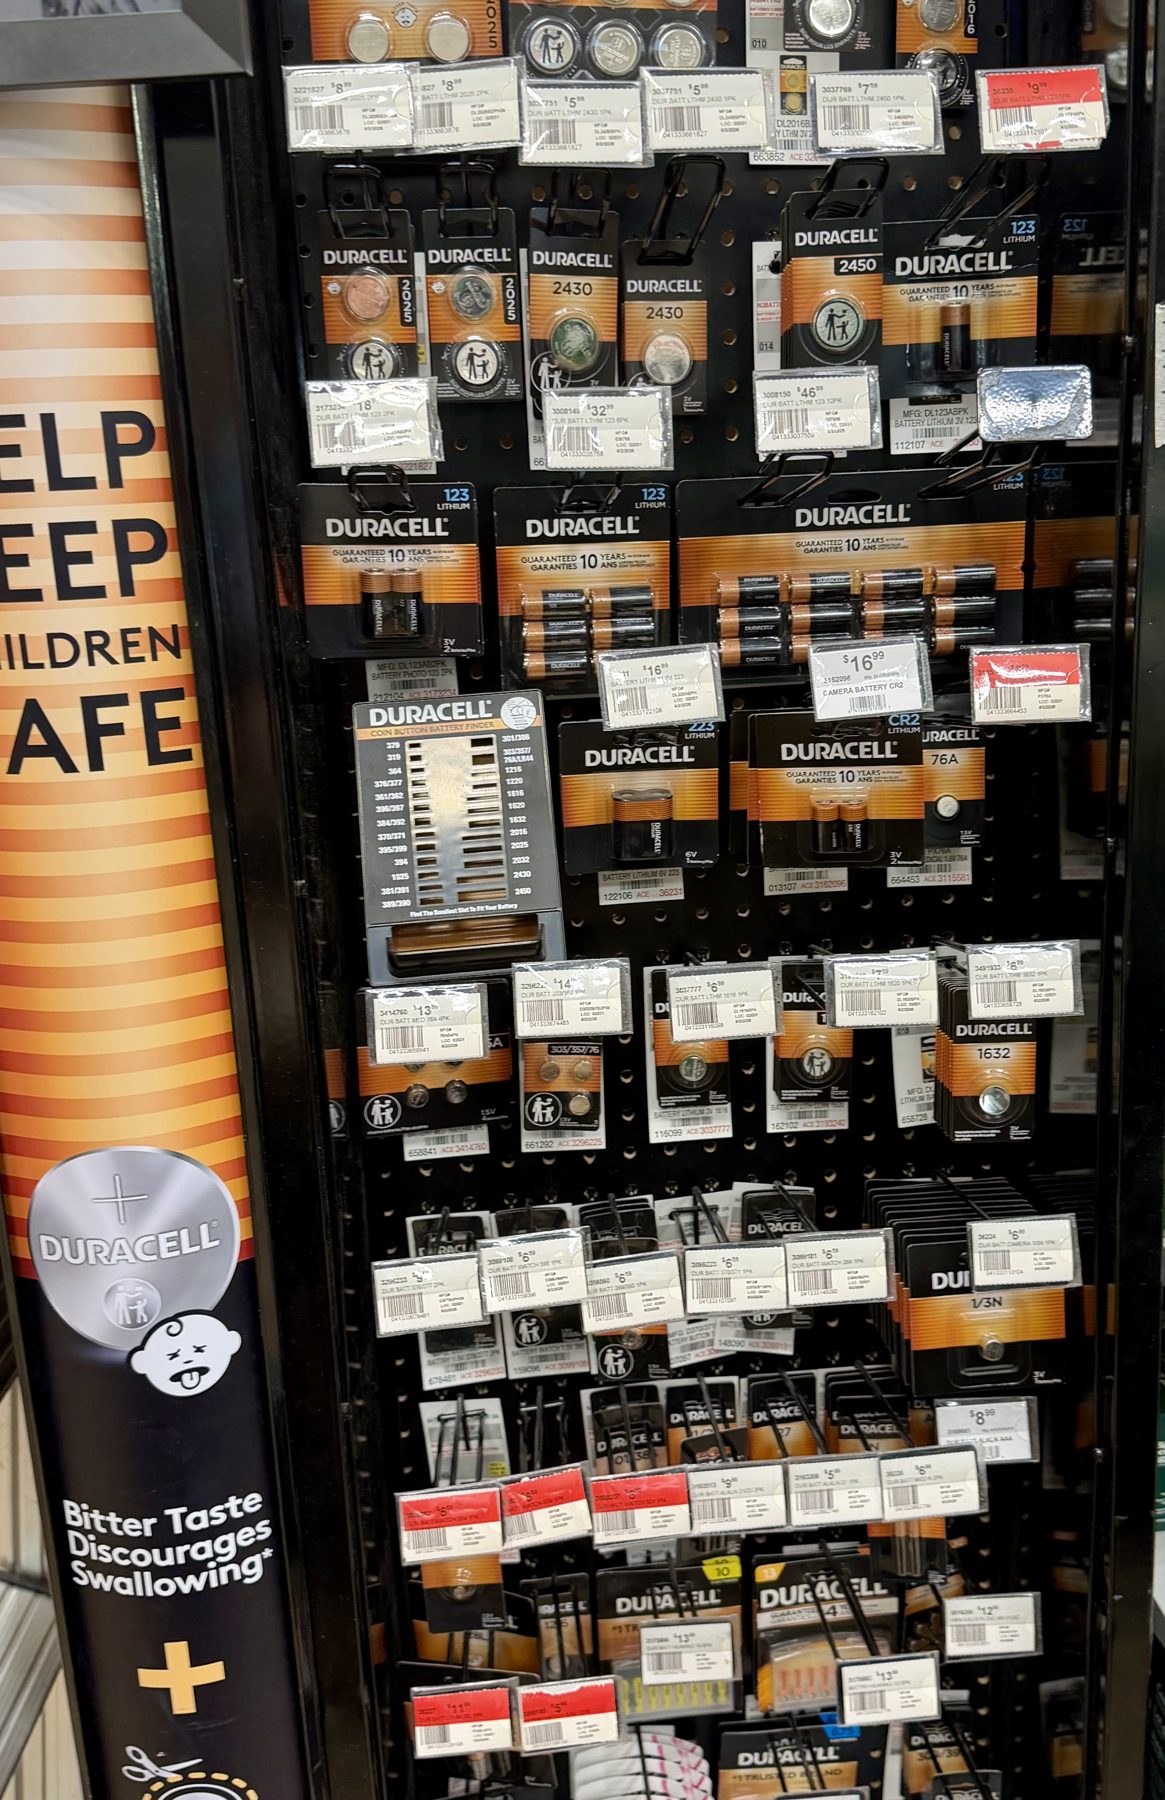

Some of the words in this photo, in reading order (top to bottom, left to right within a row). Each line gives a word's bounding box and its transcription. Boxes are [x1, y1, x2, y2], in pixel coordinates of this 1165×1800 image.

[752, 40, 767, 48] 010
[754, 152, 785, 161] 663852
[1010, 220, 1036, 234] 123
[794, 228, 878, 247] DURACELL
[1003, 235, 1036, 243] LITHIUM
[323, 250, 407, 264] DURACELL
[428, 248, 512, 263] DURACELL
[532, 251, 613, 267] DURACELL
[839, 258, 877, 273] 2450
[895, 251, 1014, 276] DURACELL
[552, 282, 593, 296] 2430
[626, 279, 702, 293] DURACELL
[899, 286, 950, 296] GUARANTEED
[952, 285, 969, 298] 10
[971, 283, 995, 291] YEARS
[401, 279, 412, 323] 2025
[505, 278, 516, 320] 2025
[645, 307, 683, 320] 2430
[759, 342, 773, 351] 014
[894, 418, 926, 428] BATTERY
[927, 416, 954, 427] LITHIUM
[0, 410, 156, 493] ELP
[895, 441, 926, 450] 112107
[443, 488, 469, 501] 123
[641, 487, 666, 500] 123
[795, 504, 911, 527] DURACELL
[325, 518, 449, 537] DURACELL
[525, 516, 640, 538] DURACELL
[804, 546, 843, 554] GARANTIES
[845, 538, 860, 551] 10
[0, 518, 168, 603] EEP
[388, 549, 405, 563] 10
[520, 555, 577, 564] GUARANTEED
[580, 554, 598, 569] 10
[530, 563, 578, 571] GARANTIES
[0, 623, 182, 670] ILDREN
[823, 687, 854, 696] CAMERA
[855, 683, 888, 693] BATTERY
[369, 700, 492, 727] DURACELL
[889, 714, 920, 725] CR2
[6, 687, 194, 775] AFE
[370, 729, 393, 737] COIN
[394, 726, 428, 736] BUTTON
[429, 723, 464, 733] BATTERY
[465, 721, 495, 730] FINDER
[922, 729, 980, 742] URACELL
[585, 746, 695, 766] DURACELL
[780, 741, 898, 761] DURACELL
[931, 754, 959, 765] 76A
[838, 770, 855, 782] 10
[512, 856, 530, 864] 2032
[889, 851, 902, 859] 3V
[603, 872, 631, 881] BATTERY
[633, 871, 657, 880] LITHIUM
[668, 869, 680, 877] 223
[892, 876, 920, 884] 664453
[768, 883, 797, 891] 013107
[604, 892, 632, 900] 122106
[497, 903, 518, 911] Battery
[956, 1023, 1033, 1037] DURACELL
[550, 1045, 600, 1054] 303/357/76
[976, 1048, 1011, 1059] 1632
[38, 1221, 221, 1265] DURACELL
[971, 1297, 1003, 1309] 1/3N
[62, 1499, 158, 1538] Bitter
[163, 1491, 263, 1535] Taste
[66, 1518, 273, 1568] Discourages
[715, 1567, 729, 1576] 10
